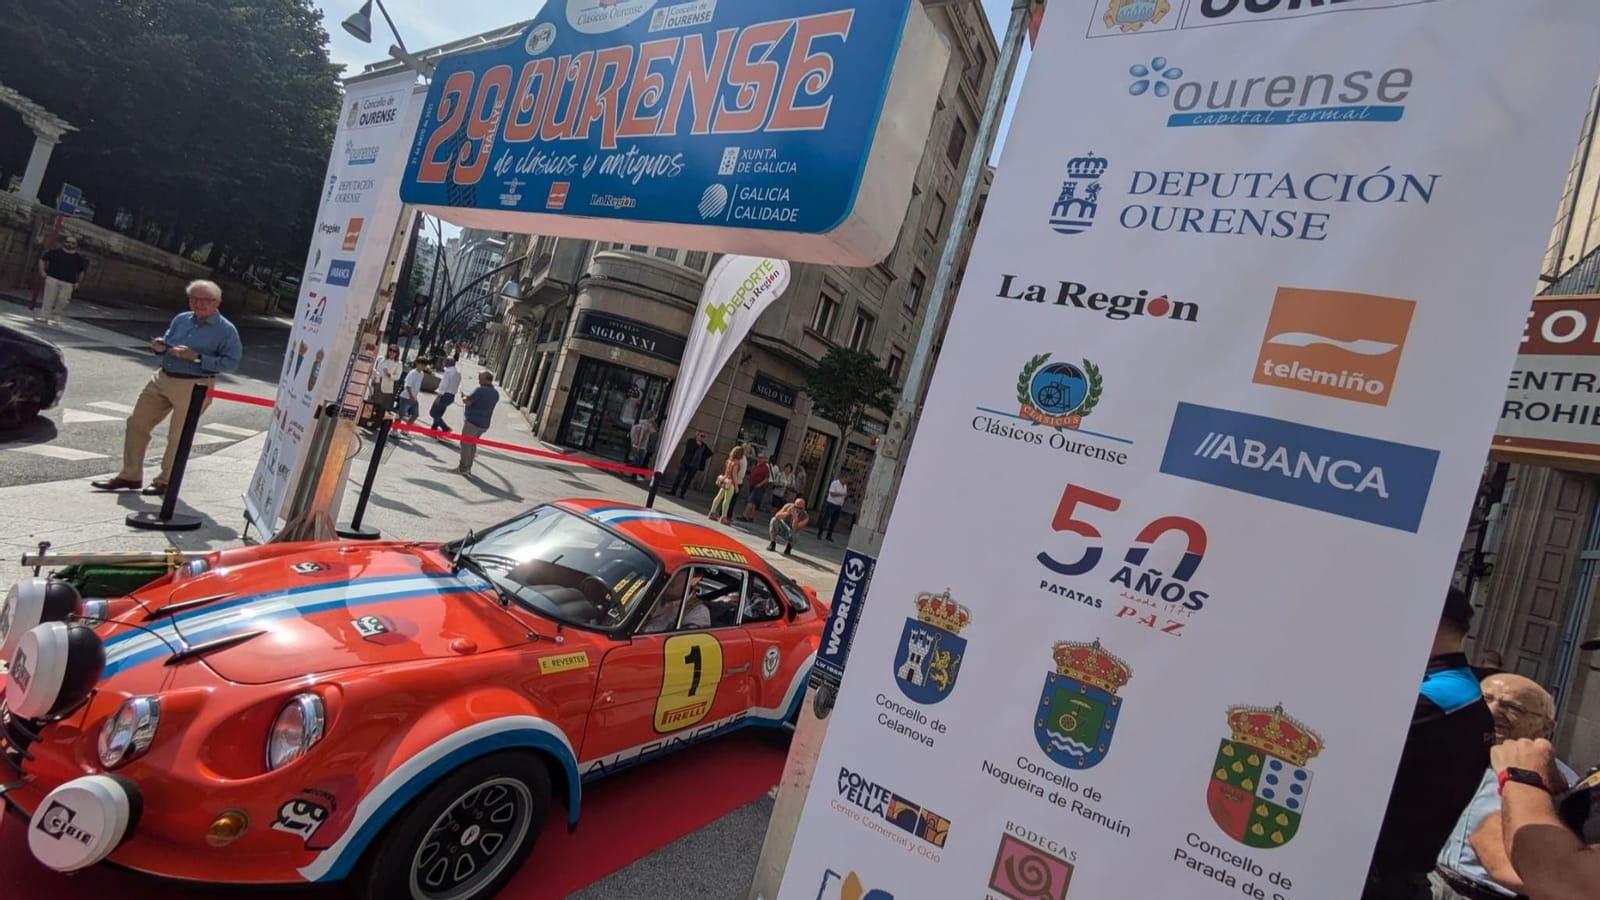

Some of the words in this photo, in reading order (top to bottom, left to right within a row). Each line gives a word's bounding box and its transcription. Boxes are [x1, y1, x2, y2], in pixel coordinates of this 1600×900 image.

[668, 10, 712, 27] OURENSE
[503, 8, 855, 150] OURENSE
[1173, 67, 1413, 111] ourense
[360, 108, 397, 126] OURENSE
[416, 65, 514, 184] 29
[481, 99, 504, 154] RALLYE
[1193, 108, 1275, 125] capital
[1285, 106, 1372, 122] termal
[494, 148, 513, 177] de
[515, 146, 578, 176] clásicos
[582, 153, 598, 179] y
[600, 145, 686, 185] antiguos
[737, 162, 752, 173] DE
[754, 162, 798, 173] GALICIA
[741, 148, 777, 160] XUNTA
[740, 187, 790, 202] GALICIA
[1127, 165, 1443, 205] DEPUTACIÓN
[734, 206, 800, 222] CALIDADE
[1119, 205, 1331, 241] OURENSE
[726, 259, 774, 316] DEPORTE
[743, 297, 755, 310] La
[753, 270, 780, 298] Región
[996, 274, 1046, 304] La
[1053, 280, 1199, 323] Región
[591, 325, 625, 341] SIGLO
[630, 335, 656, 351] XXI
[1262, 357, 1385, 396] telemiño
[972, 415, 1043, 445] Clásicos
[1049, 433, 1128, 465] Ourense
[1036, 483, 1208, 582] 50
[682, 545, 749, 564] MICHELIN
[1039, 580, 1103, 609] PATATAS
[1109, 566, 1210, 611] AÑOS
[826, 586, 855, 656] WORK
[1115, 605, 1186, 637] PAZ
[684, 645, 703, 697] 1
[661, 701, 709, 725] PIRELLI
[876, 693, 927, 725] Concello
[930, 719, 947, 734] de
[878, 713, 934, 748] Celanova
[838, 766, 892, 804] PONTE
[838, 780, 884, 818] VELLA
[981, 759, 1044, 798] Nogueira
[1048, 791, 1067, 808] de
[1071, 799, 1132, 838] Ramuín
[1017, 756, 1079, 793] Concello
[1083, 786, 1102, 803] de
[831, 799, 860, 821] Centro
[862, 816, 907, 847] Comercial
[908, 841, 916, 852] y
[917, 846, 941, 863] Ocio
[1005, 820, 1078, 862] BODEGAS
[1173, 848, 1236, 888] Parada
[1242, 882, 1265, 900] de
[1186, 832, 1263, 878] Concello
[1268, 872, 1293, 891] de
